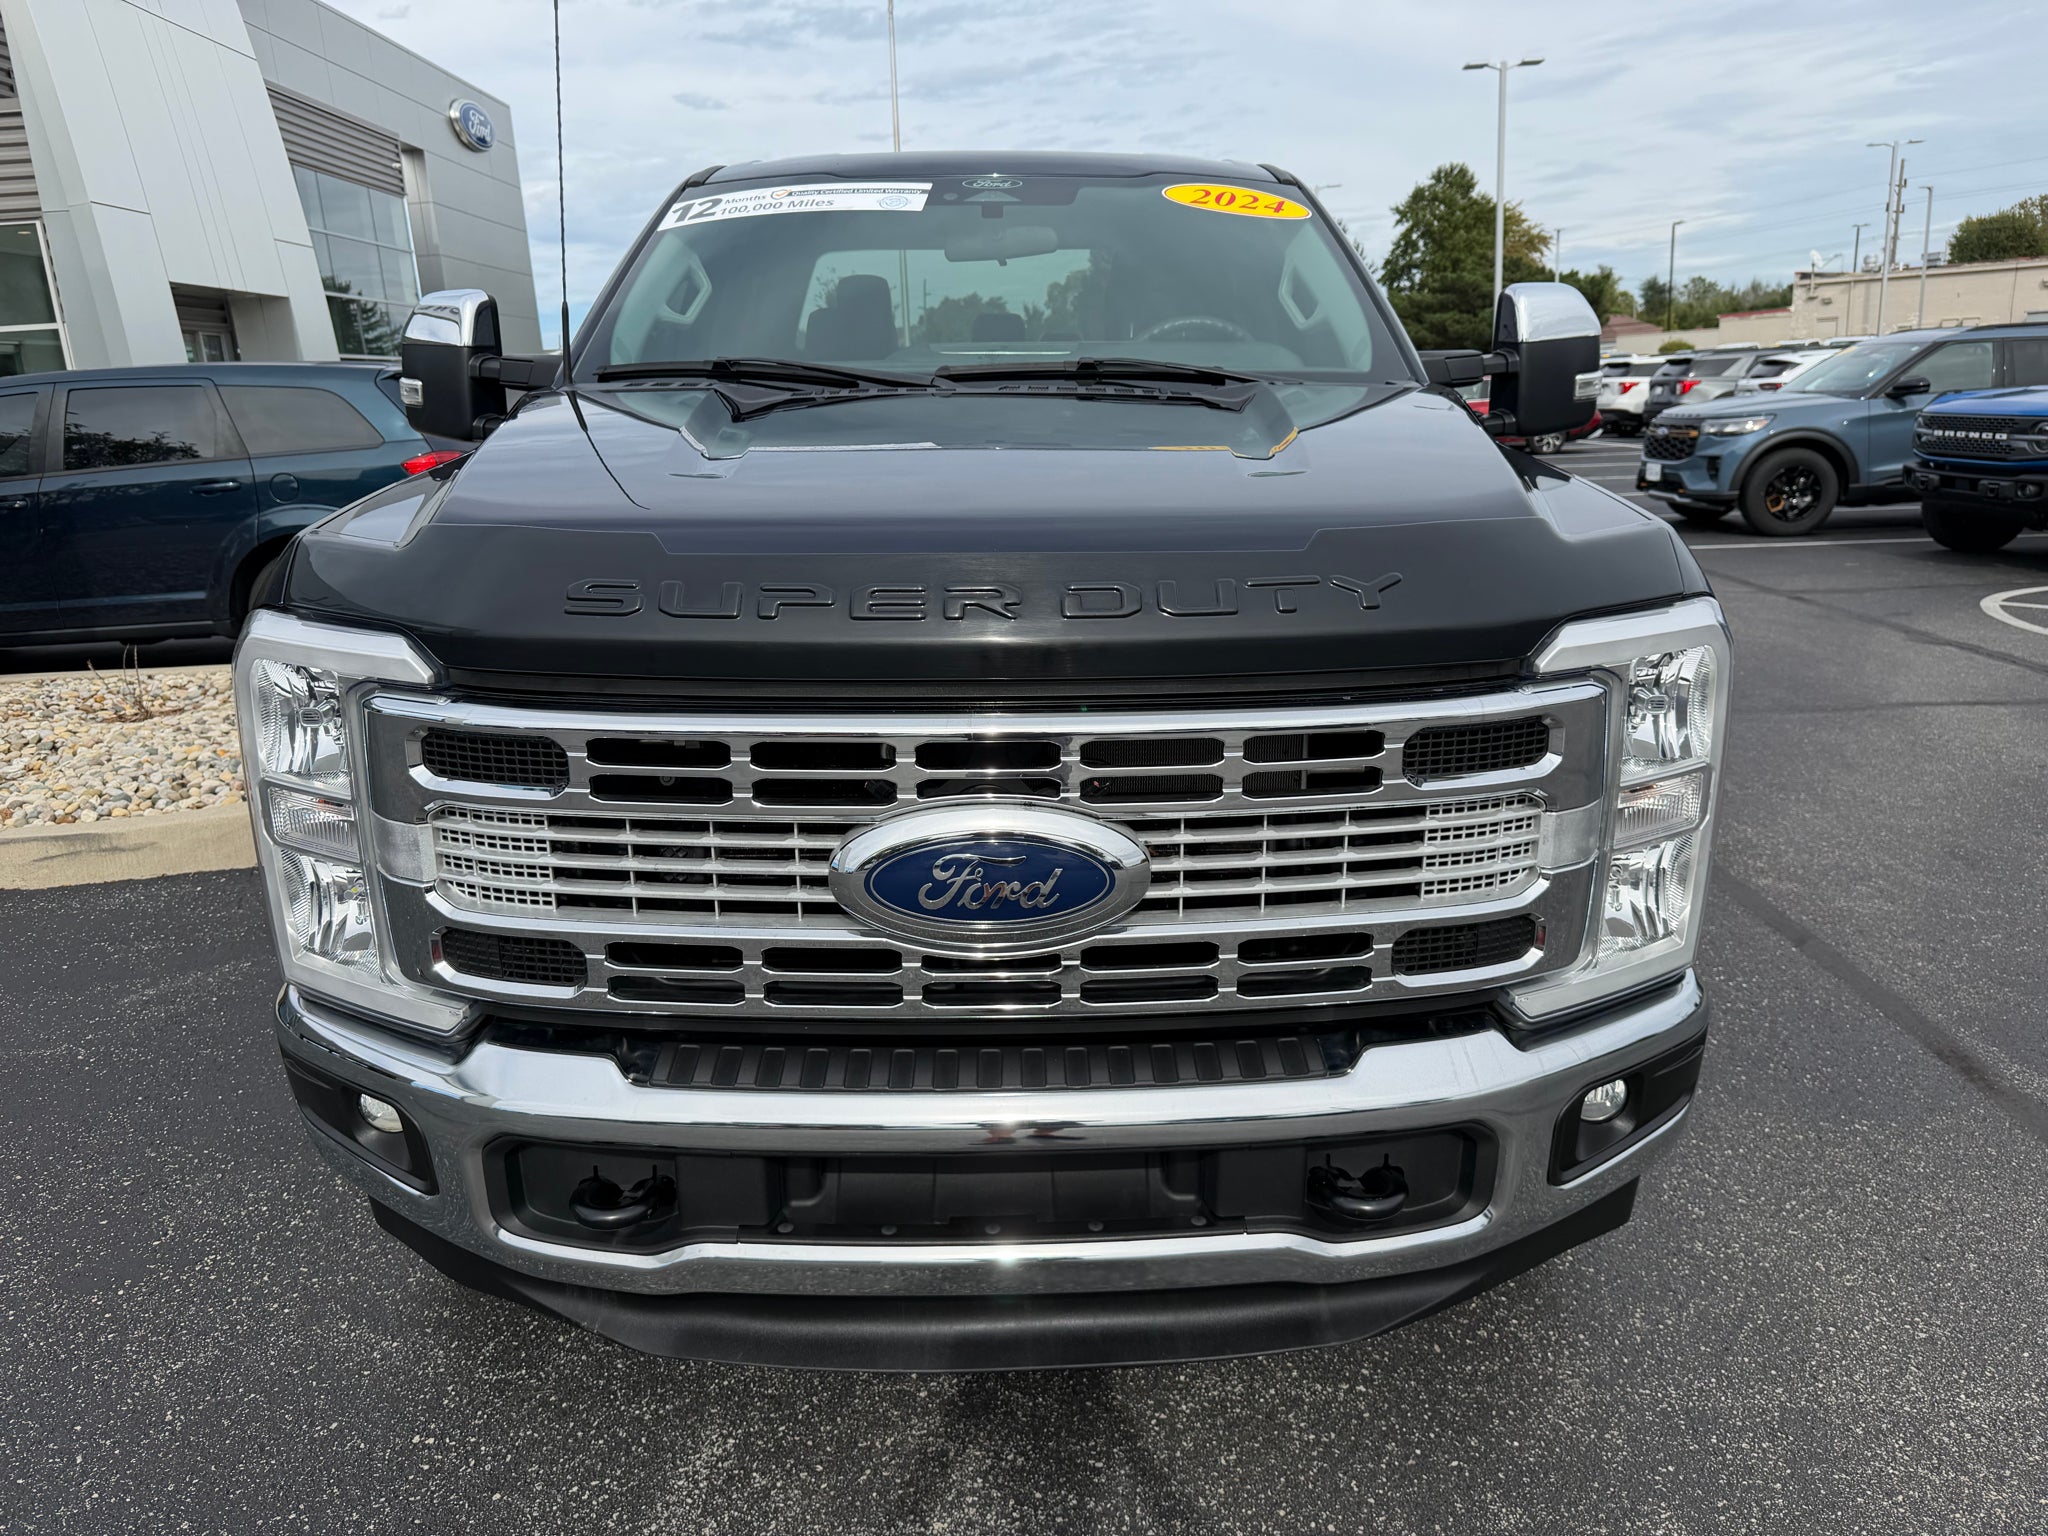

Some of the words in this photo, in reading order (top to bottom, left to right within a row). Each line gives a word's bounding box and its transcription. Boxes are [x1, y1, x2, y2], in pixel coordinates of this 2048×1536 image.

[469, 109, 491, 142] Ford
[724, 194, 767, 205] Months
[820, 188, 853, 196] Certified
[884, 188, 922, 196] Warranty
[1190, 189, 1286, 214] 2024
[671, 198, 723, 223] 12
[720, 201, 783, 216] 100,000
[787, 199, 835, 209] Miles
[1933, 429, 2008, 440] BRONCO
[563, 577, 1023, 621] SUPER
[1060, 572, 1403, 621] DUTY
[917, 853, 1064, 910] Ford
